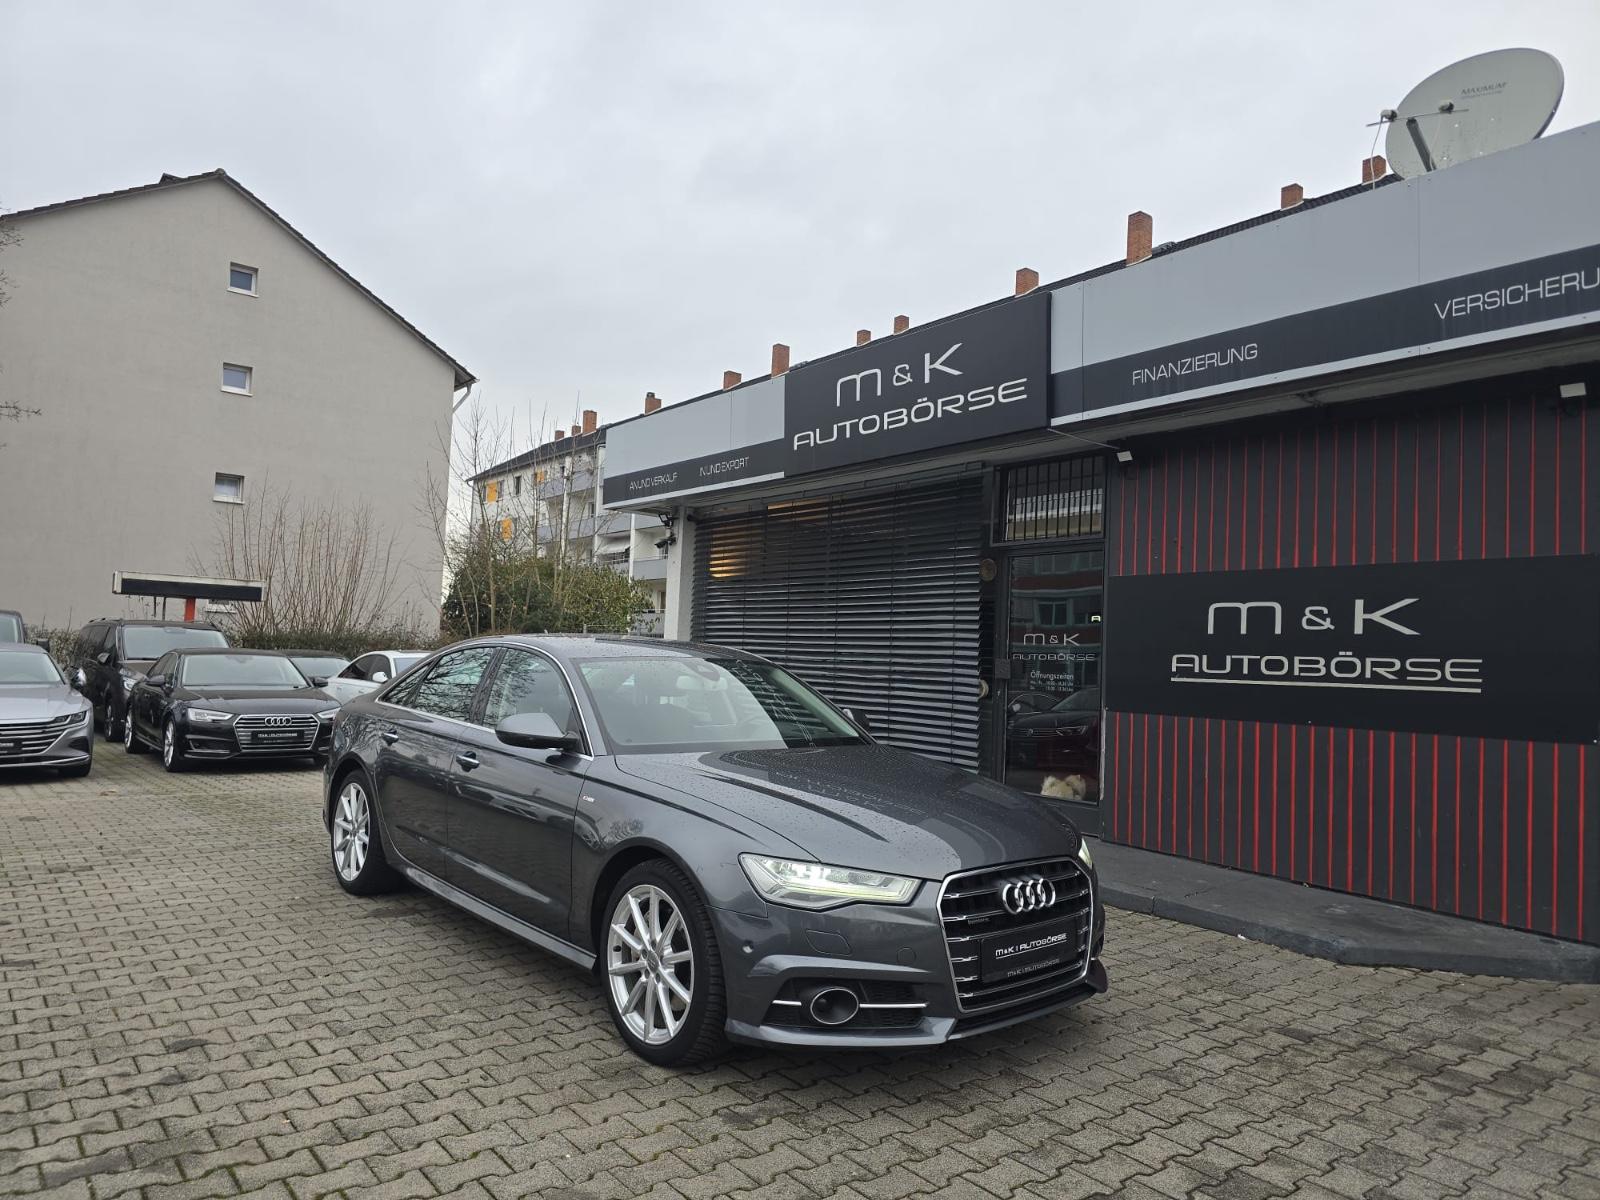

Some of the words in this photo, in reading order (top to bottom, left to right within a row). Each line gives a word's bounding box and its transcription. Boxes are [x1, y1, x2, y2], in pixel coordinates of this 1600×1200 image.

[836, 368, 882, 407] M
[893, 364, 913, 386] &
[924, 343, 964, 384] K
[1132, 343, 1258, 385] FINANZIERUNG
[793, 378, 1028, 451] AUTOBÖRSE
[1207, 601, 1282, 635] M
[1301, 606, 1335, 631] &
[1354, 598, 1421, 635] K
[1023, 633, 1046, 646] M
[1063, 633, 1080, 647] K
[1012, 652, 1096, 661] AUTOBÖRSE
[1171, 651, 1483, 683] AUTOBÖRSE
[1030, 669, 1074, 681] Öffnungszeiten
[1020, 933, 1067, 951] AUTOBÖRSE
